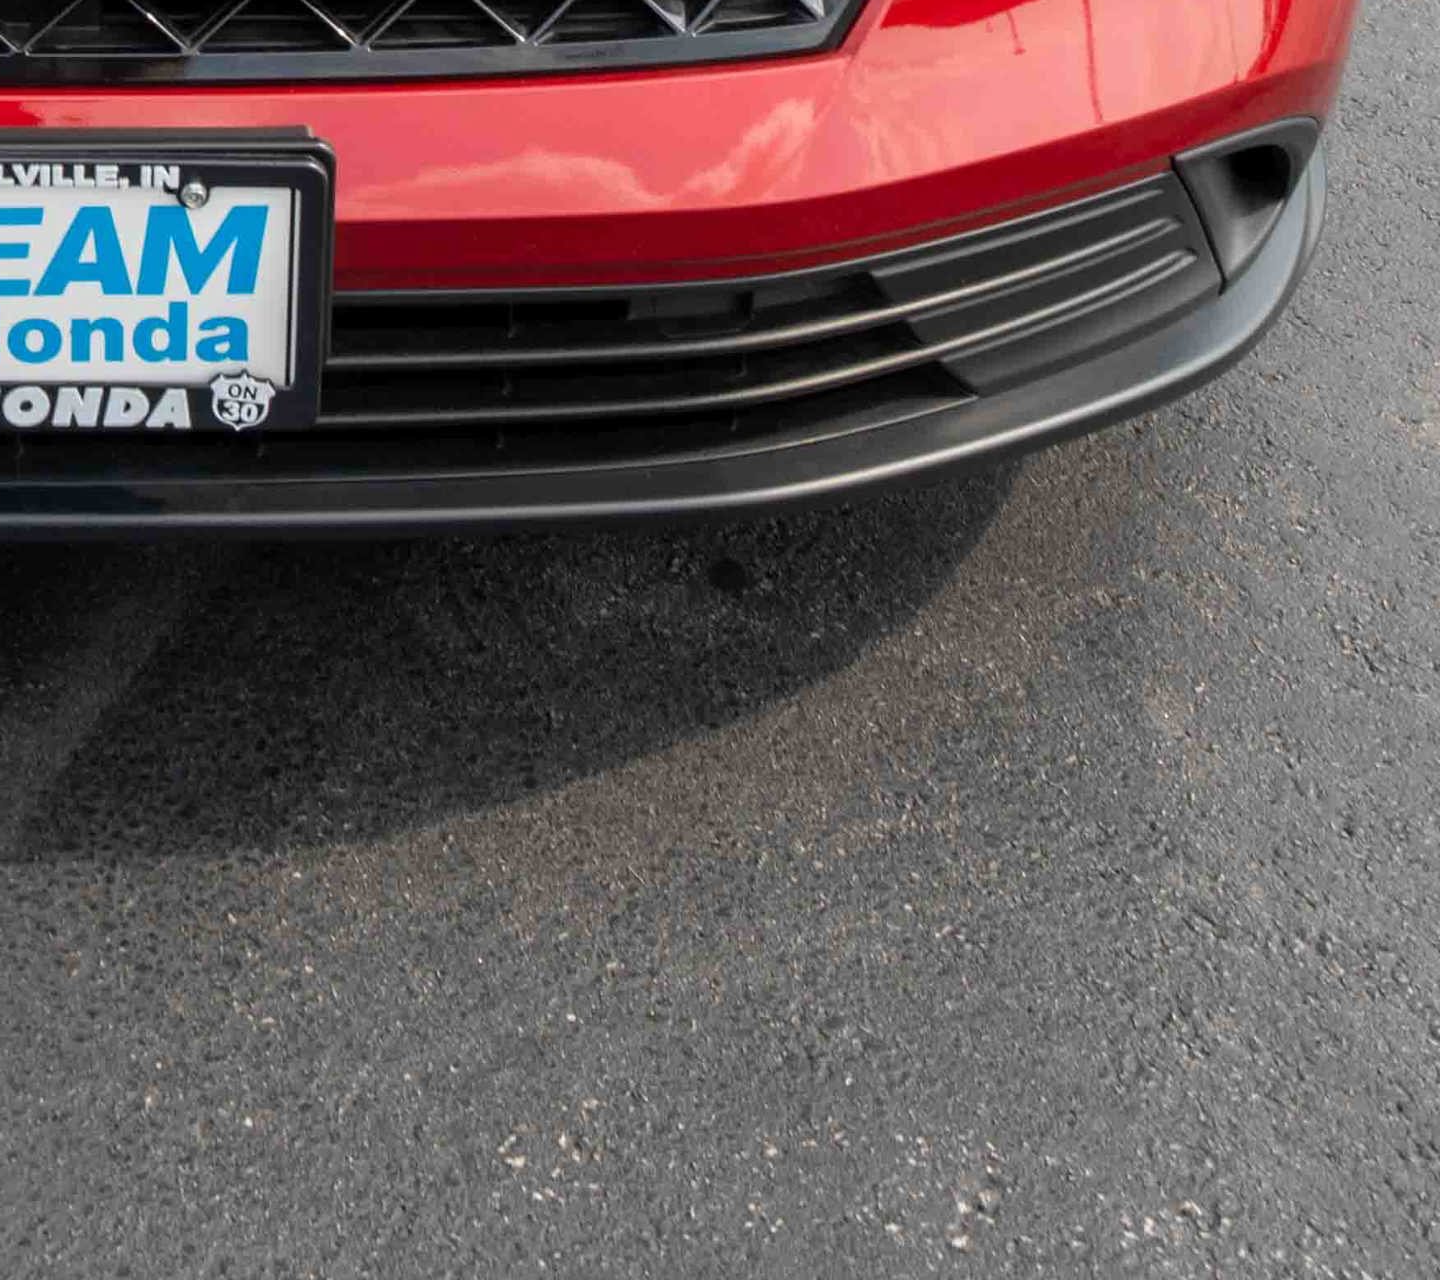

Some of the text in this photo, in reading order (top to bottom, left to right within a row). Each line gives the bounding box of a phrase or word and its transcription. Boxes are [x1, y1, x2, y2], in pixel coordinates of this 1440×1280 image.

[140, 164, 181, 190] IN
[227, 383, 259, 402] ON
[220, 403, 261, 423] 30
